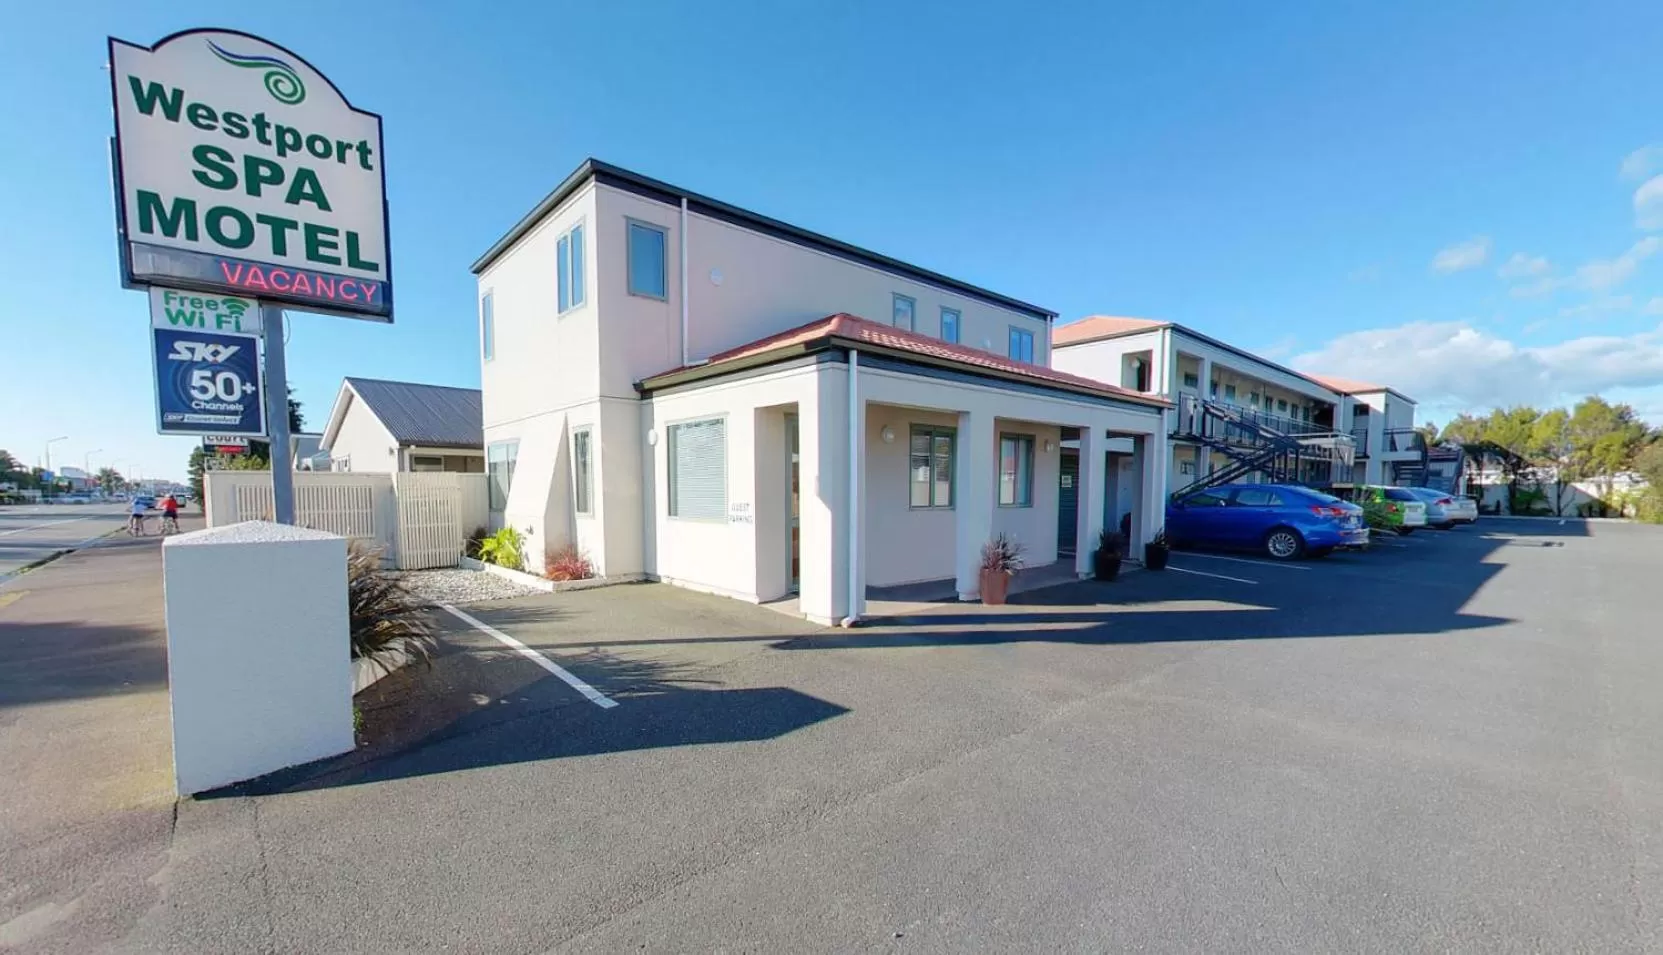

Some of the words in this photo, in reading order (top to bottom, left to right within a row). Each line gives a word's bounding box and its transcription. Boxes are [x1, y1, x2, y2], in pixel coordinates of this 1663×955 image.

[127, 75, 374, 171] Westport
[191, 144, 332, 212] SPA
[136, 189, 379, 272] MOTEL
[220, 260, 378, 304] VACANCY
[163, 290, 219, 311] Free
[164, 307, 205, 329] Wi
[215, 313, 242, 332] Fi
[168, 340, 241, 363] SKY
[190, 369, 256, 402] 50+
[191, 401, 244, 412] Channels
